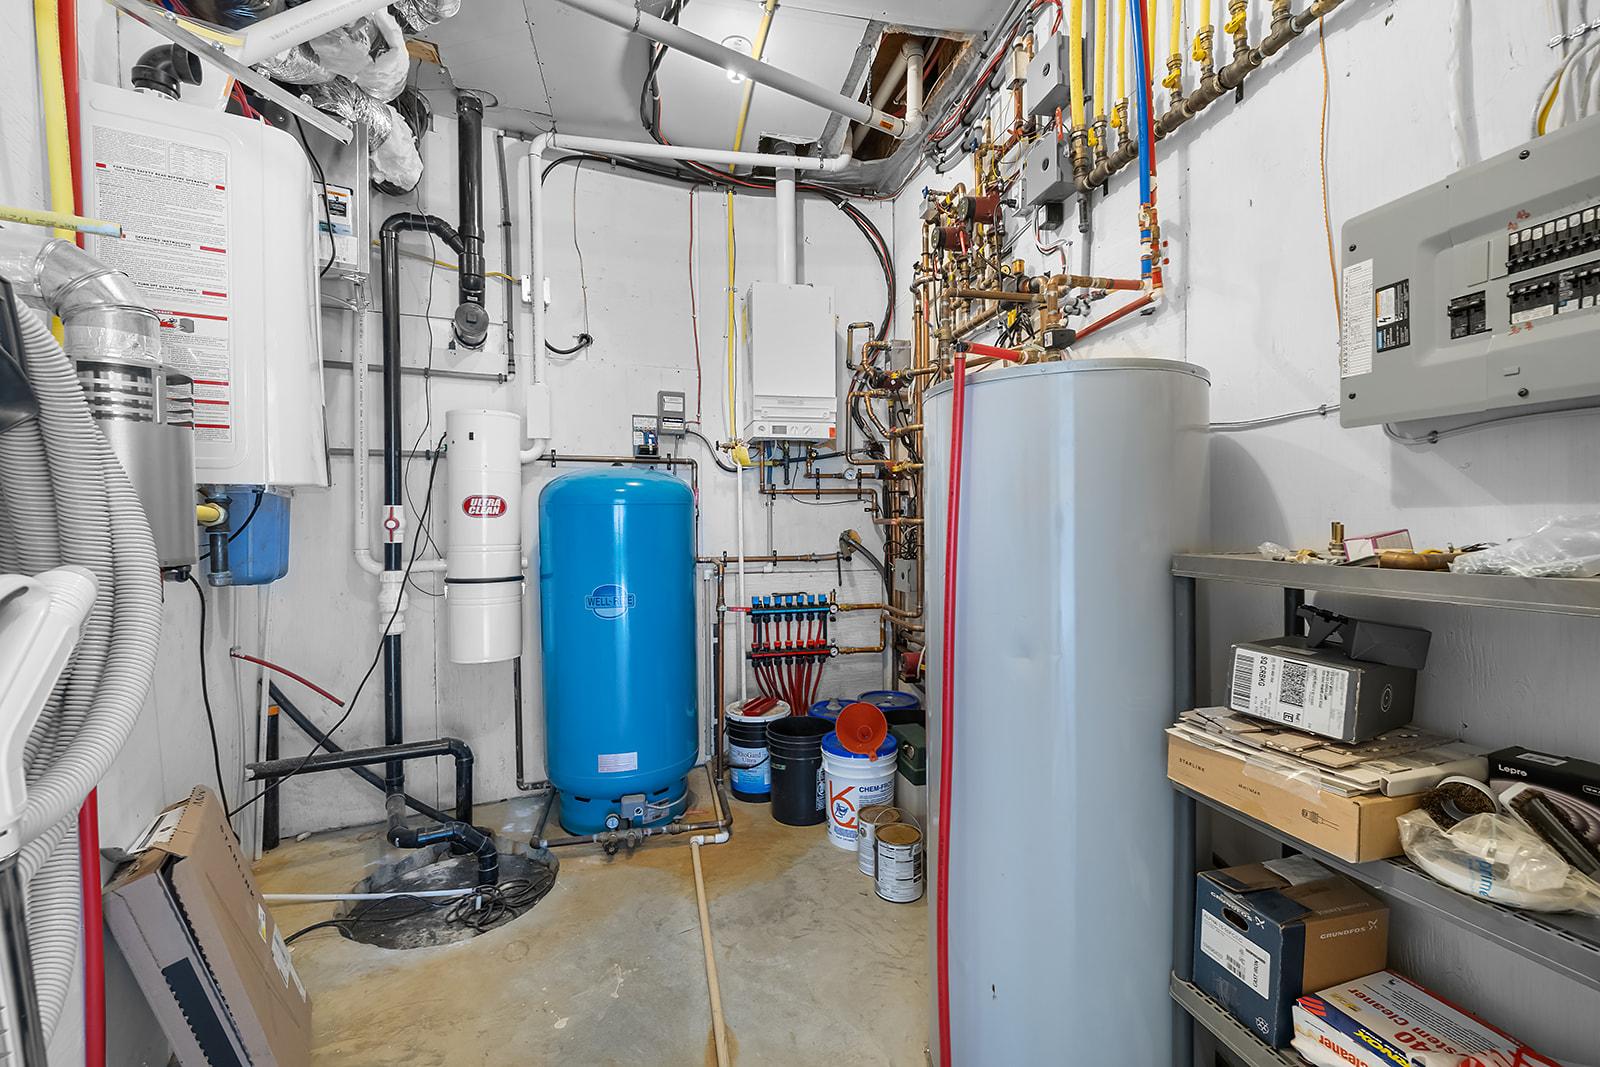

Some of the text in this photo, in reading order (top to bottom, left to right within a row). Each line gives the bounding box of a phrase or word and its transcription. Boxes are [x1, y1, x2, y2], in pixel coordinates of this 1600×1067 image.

[470, 498, 501, 507] ULTRA
[468, 506, 500, 514] CLEAN
[587, 595, 634, 606] WELL-RIE
[1498, 763, 1528, 777] Lepro
[220, 824, 255, 897] STARLINK
[1476, 858, 1494, 898] prime
[1319, 926, 1366, 941] GRUNDFOS
[1347, 988, 1409, 1026] Cleaner
